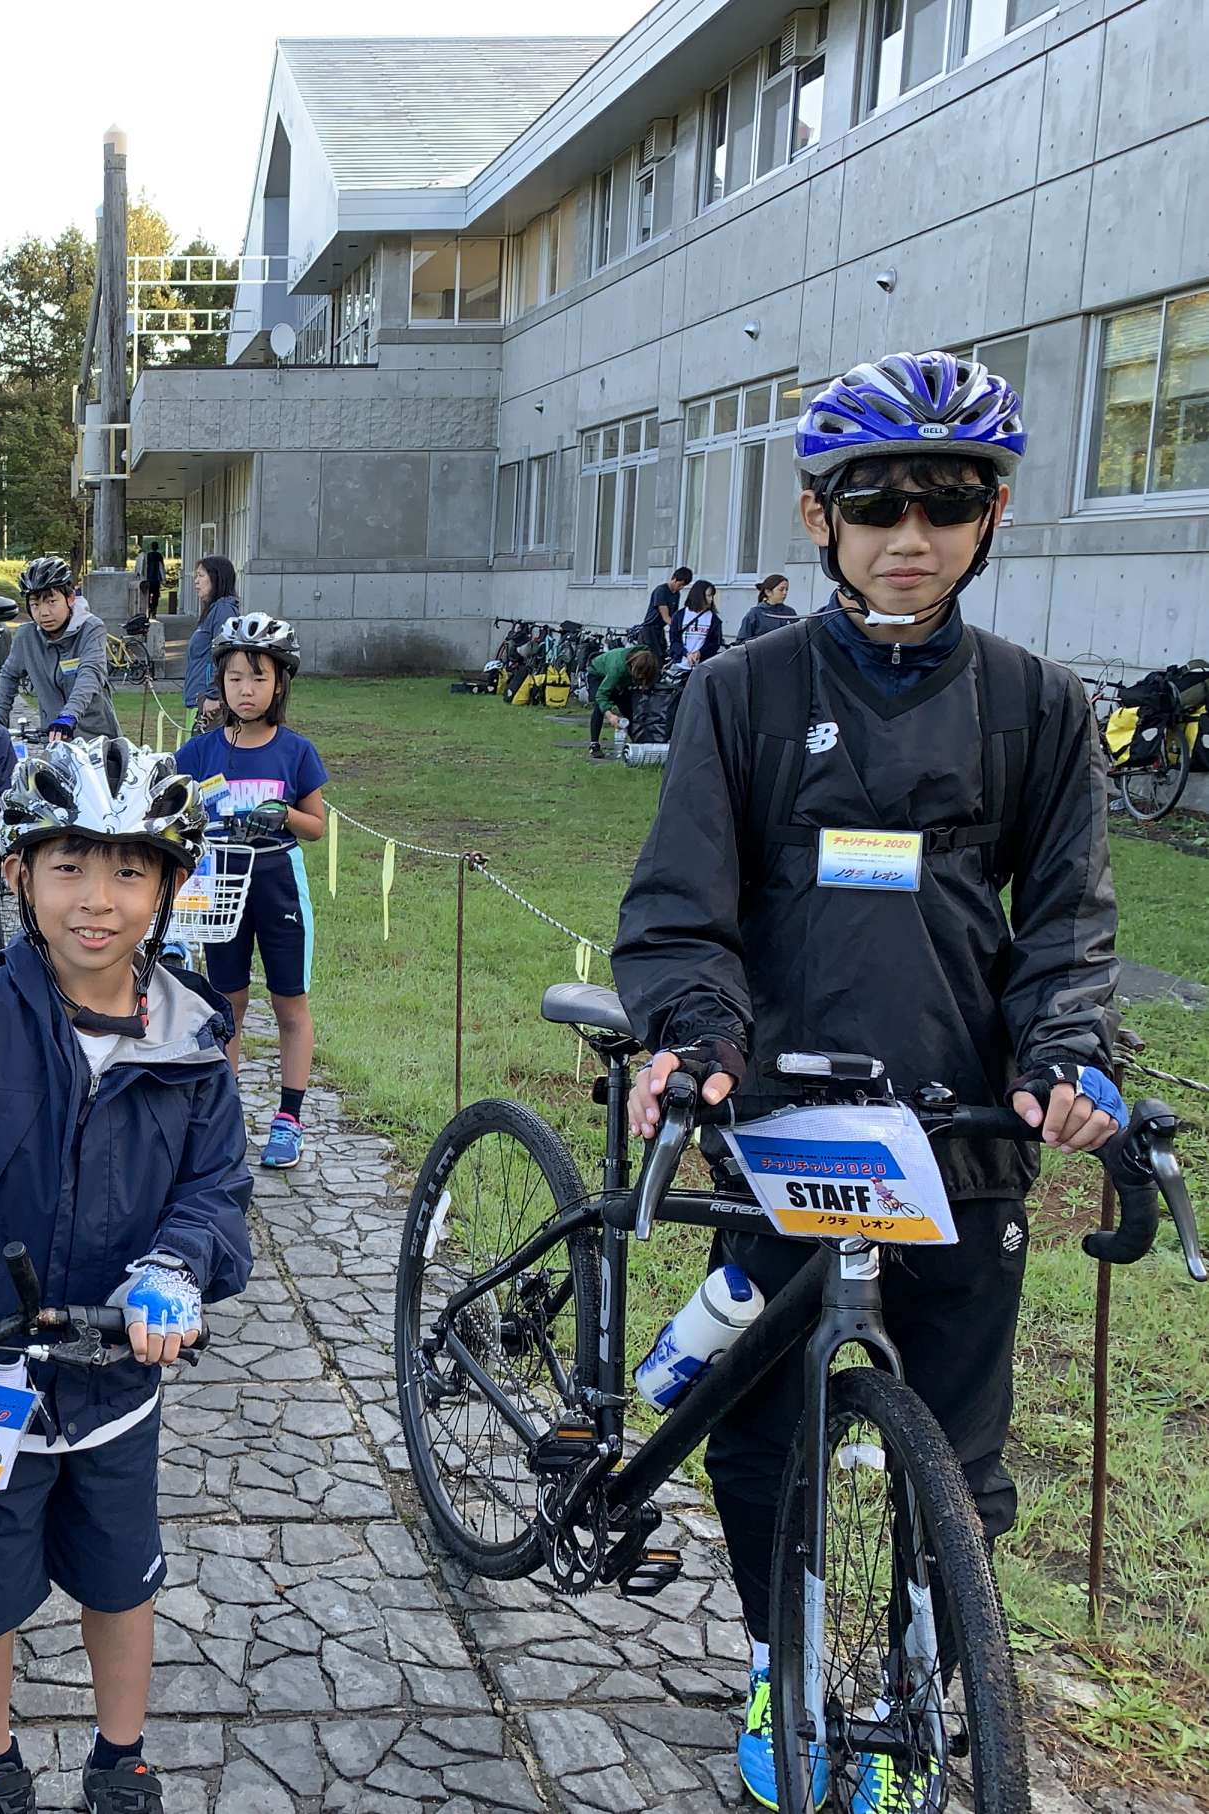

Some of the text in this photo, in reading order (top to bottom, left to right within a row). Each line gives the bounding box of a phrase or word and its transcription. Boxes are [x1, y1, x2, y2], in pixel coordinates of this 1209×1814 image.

[884, 838, 912, 849] 2020
[761, 1157, 887, 1175] チャリチャレ2020
[785, 1181, 871, 1213] STAFF
[817, 1215, 895, 1230] ノグチ レオン
